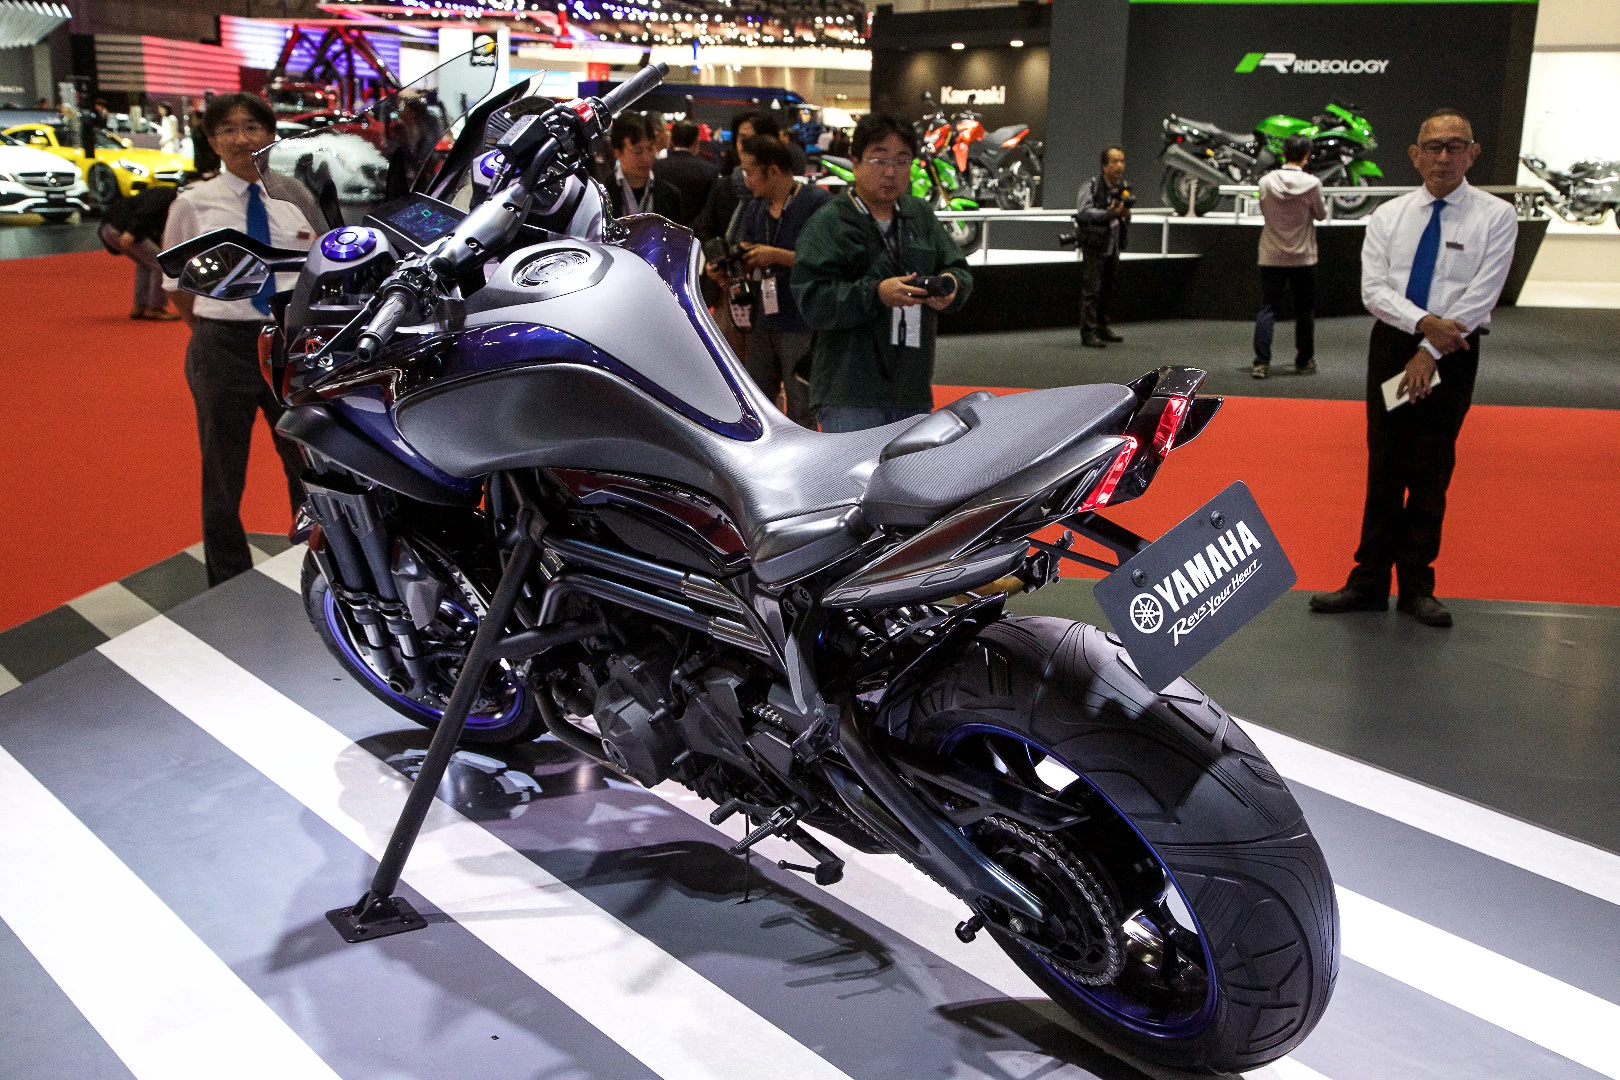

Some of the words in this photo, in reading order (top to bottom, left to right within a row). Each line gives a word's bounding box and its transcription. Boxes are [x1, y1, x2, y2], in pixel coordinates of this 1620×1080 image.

[1293, 59, 1390, 74] RIDEOLOGY
[1153, 520, 1261, 612] YAMAHA
[1167, 603, 1207, 647] Revs
[1206, 584, 1233, 616] Your
[1231, 558, 1263, 590] Heart
